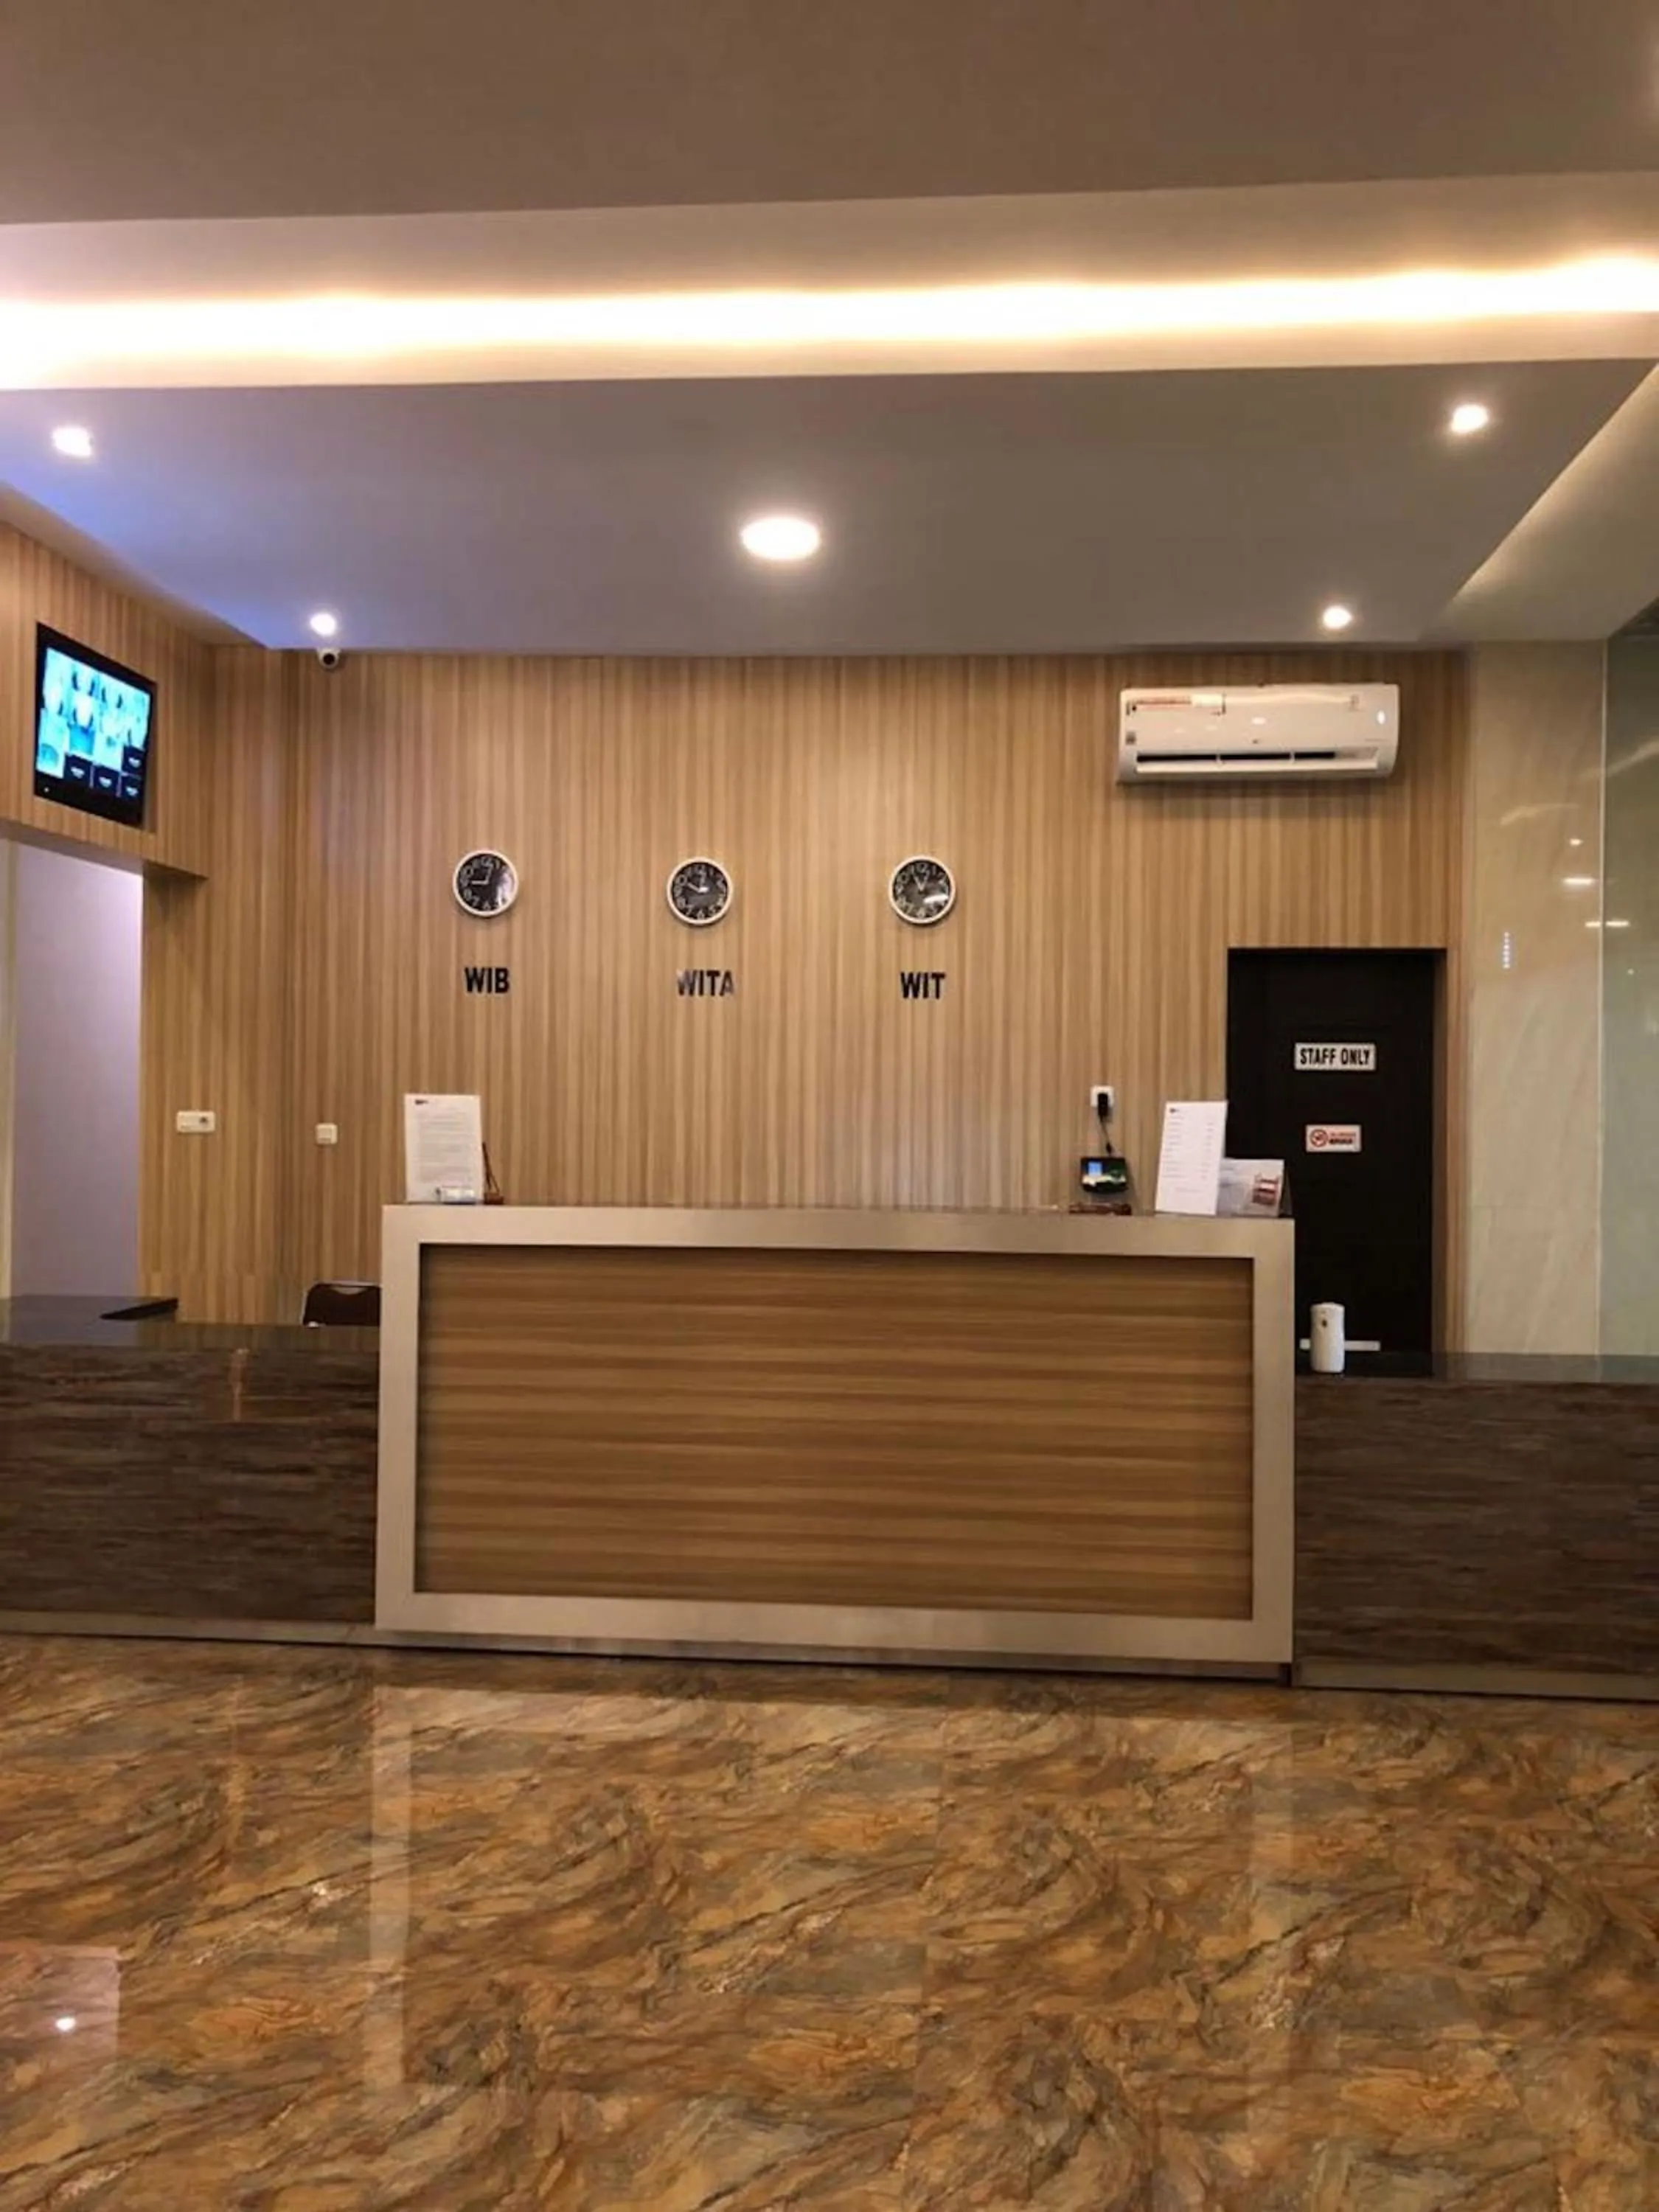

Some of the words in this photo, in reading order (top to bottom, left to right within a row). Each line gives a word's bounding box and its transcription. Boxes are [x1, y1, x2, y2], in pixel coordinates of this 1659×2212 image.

[464, 967, 509, 993] WIB
[677, 969, 734, 996] WITA
[900, 971, 947, 999] WIT
[1300, 1048, 1335, 1065] STAFF
[1341, 1048, 1370, 1065] ONLY
